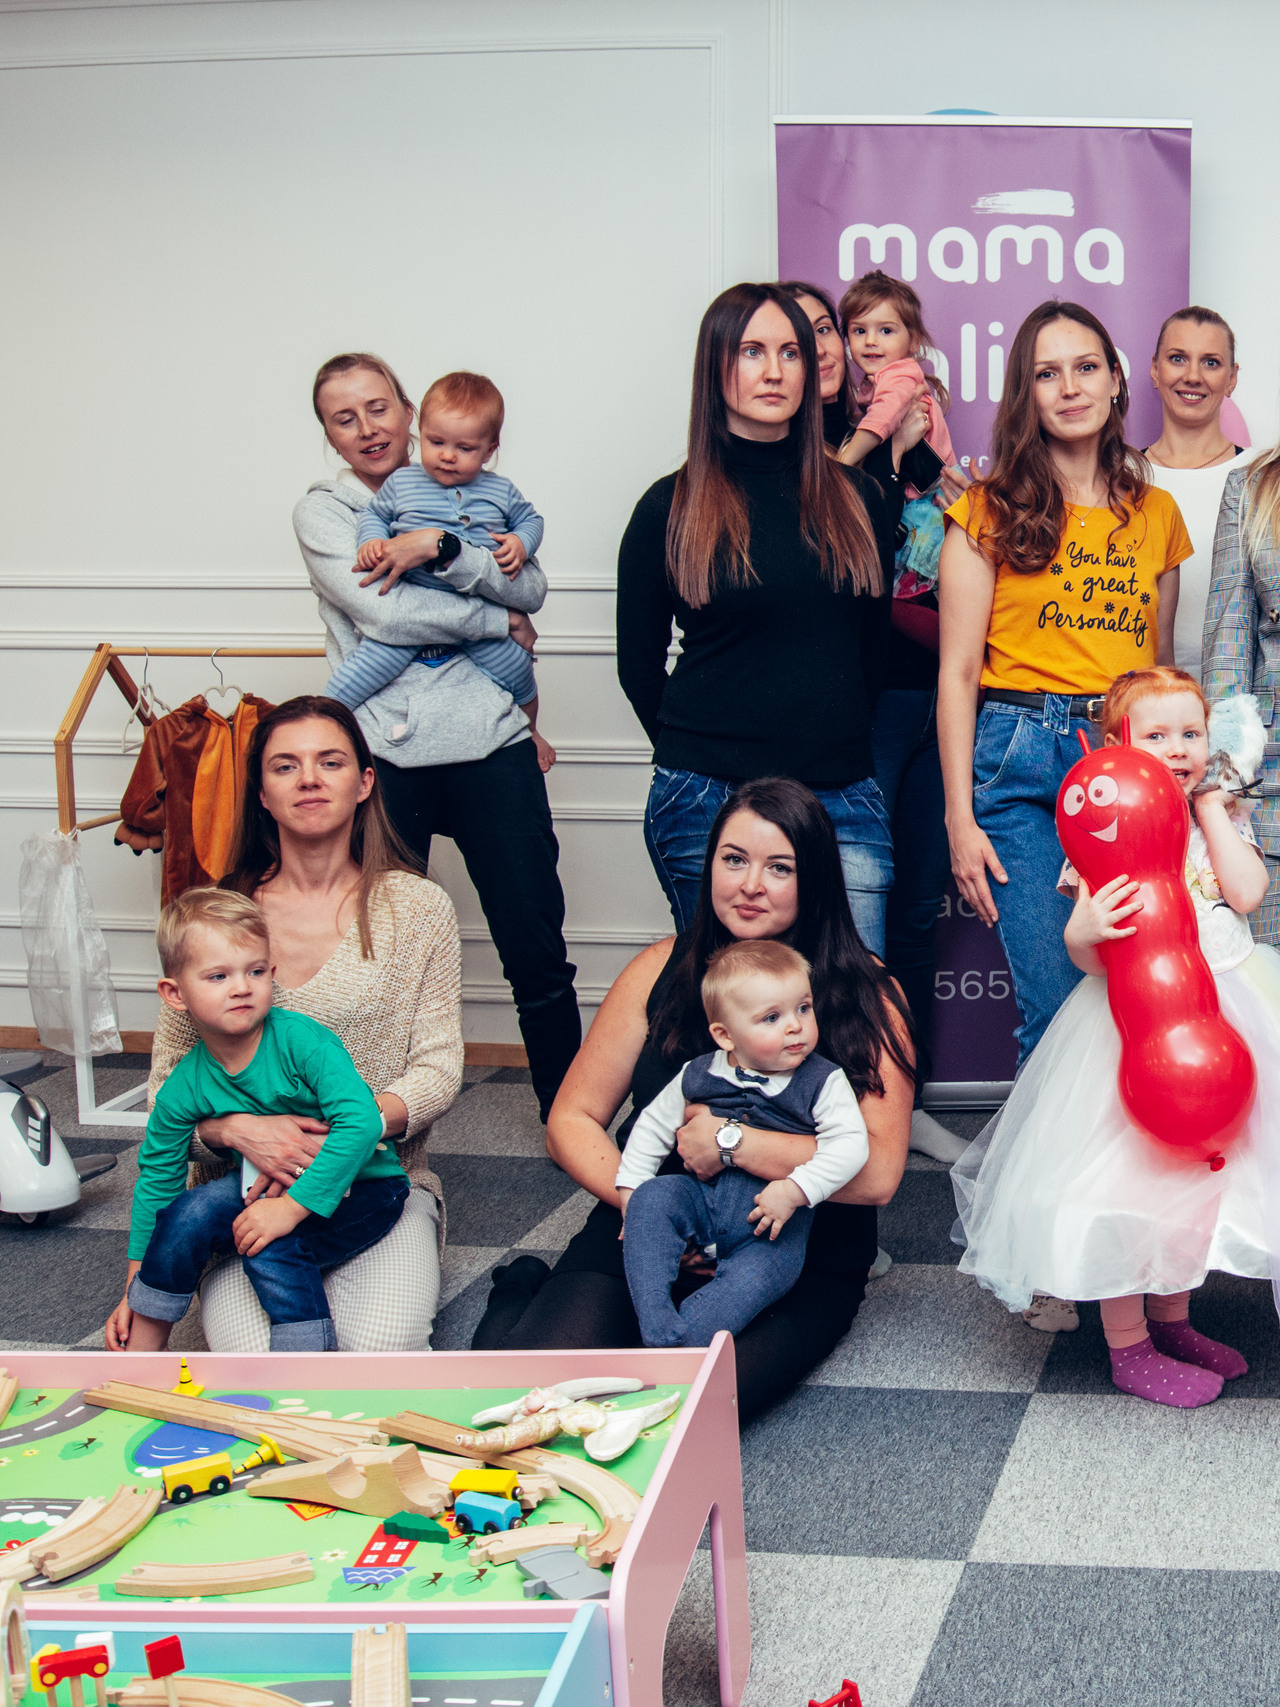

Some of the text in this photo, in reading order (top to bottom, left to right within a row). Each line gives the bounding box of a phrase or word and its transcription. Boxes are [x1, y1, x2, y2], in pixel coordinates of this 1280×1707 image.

[1066, 541, 1137, 568] You have
[1063, 572, 1139, 602] a great
[1038, 600, 1149, 648] Personality
